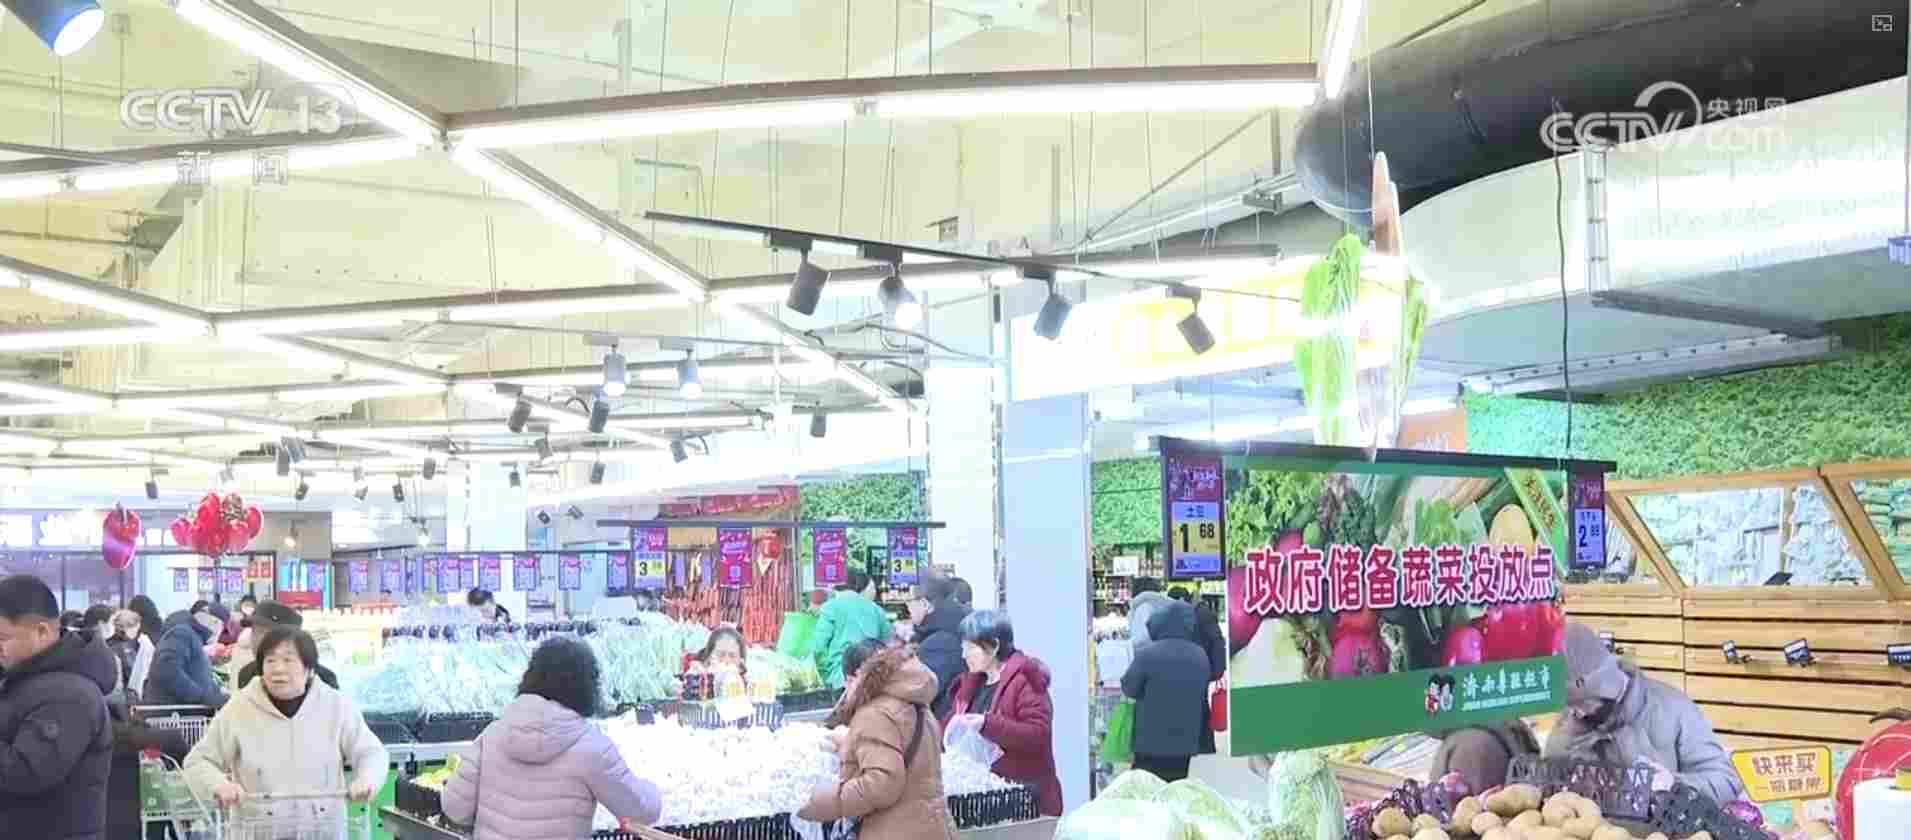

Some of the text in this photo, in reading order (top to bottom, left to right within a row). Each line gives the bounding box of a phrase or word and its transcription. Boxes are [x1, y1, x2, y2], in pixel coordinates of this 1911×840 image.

[1200, 523, 1215, 538] 68
[1244, 545, 1554, 613] 政府储备蔬菜投放点
[1752, 751, 1817, 776] 快来买
